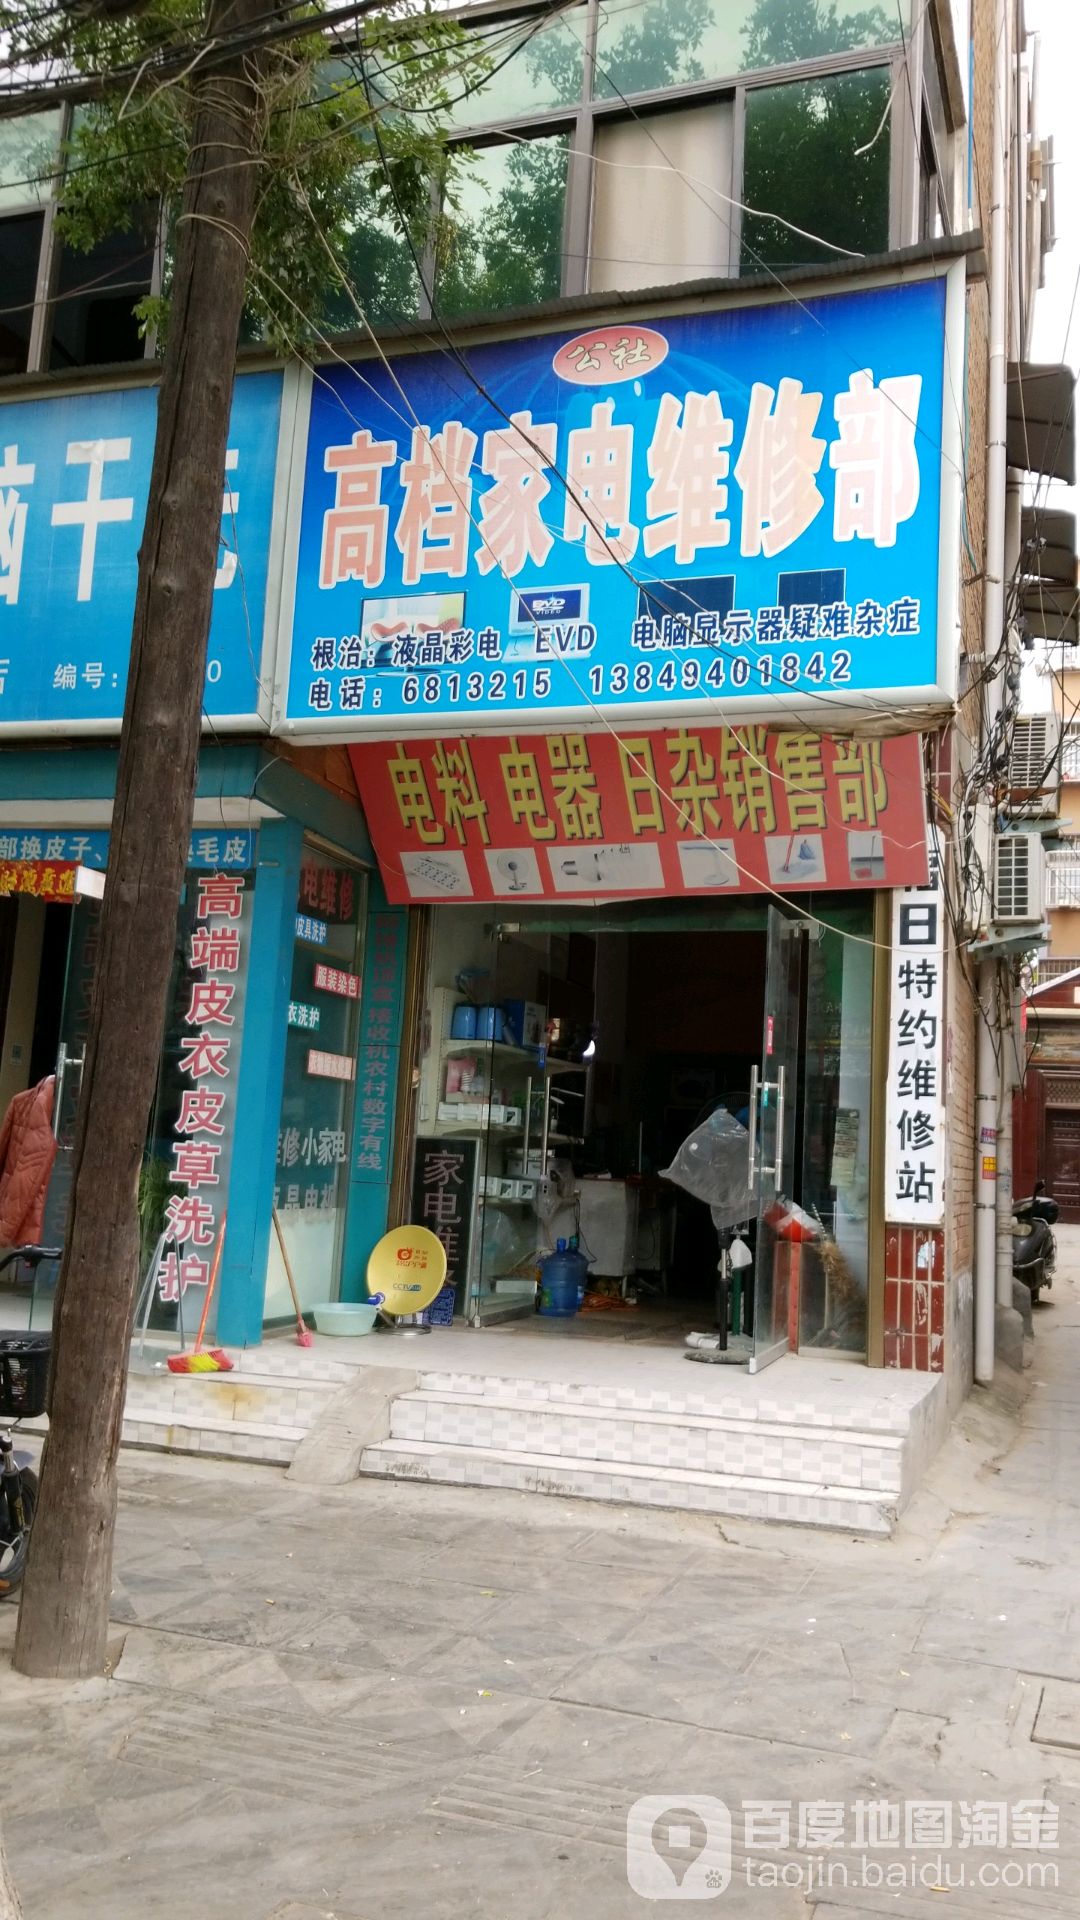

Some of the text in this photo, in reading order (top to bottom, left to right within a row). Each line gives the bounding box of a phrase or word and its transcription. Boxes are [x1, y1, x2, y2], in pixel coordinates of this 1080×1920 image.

[566, 337, 651, 373] 公社
[319, 368, 923, 590] 高档家电维修部
[535, 624, 597, 654] EVD
[632, 597, 920, 650] 电脑显示器疑难杂症
[589, 650, 852, 695] 13849401842
[187, 836, 247, 862] 毛皮
[296, 917, 327, 943] 皮具洗护
[317, 966, 358, 996] 服装染色
[159, 874, 244, 1301] 高端皮衣皮草洗护
